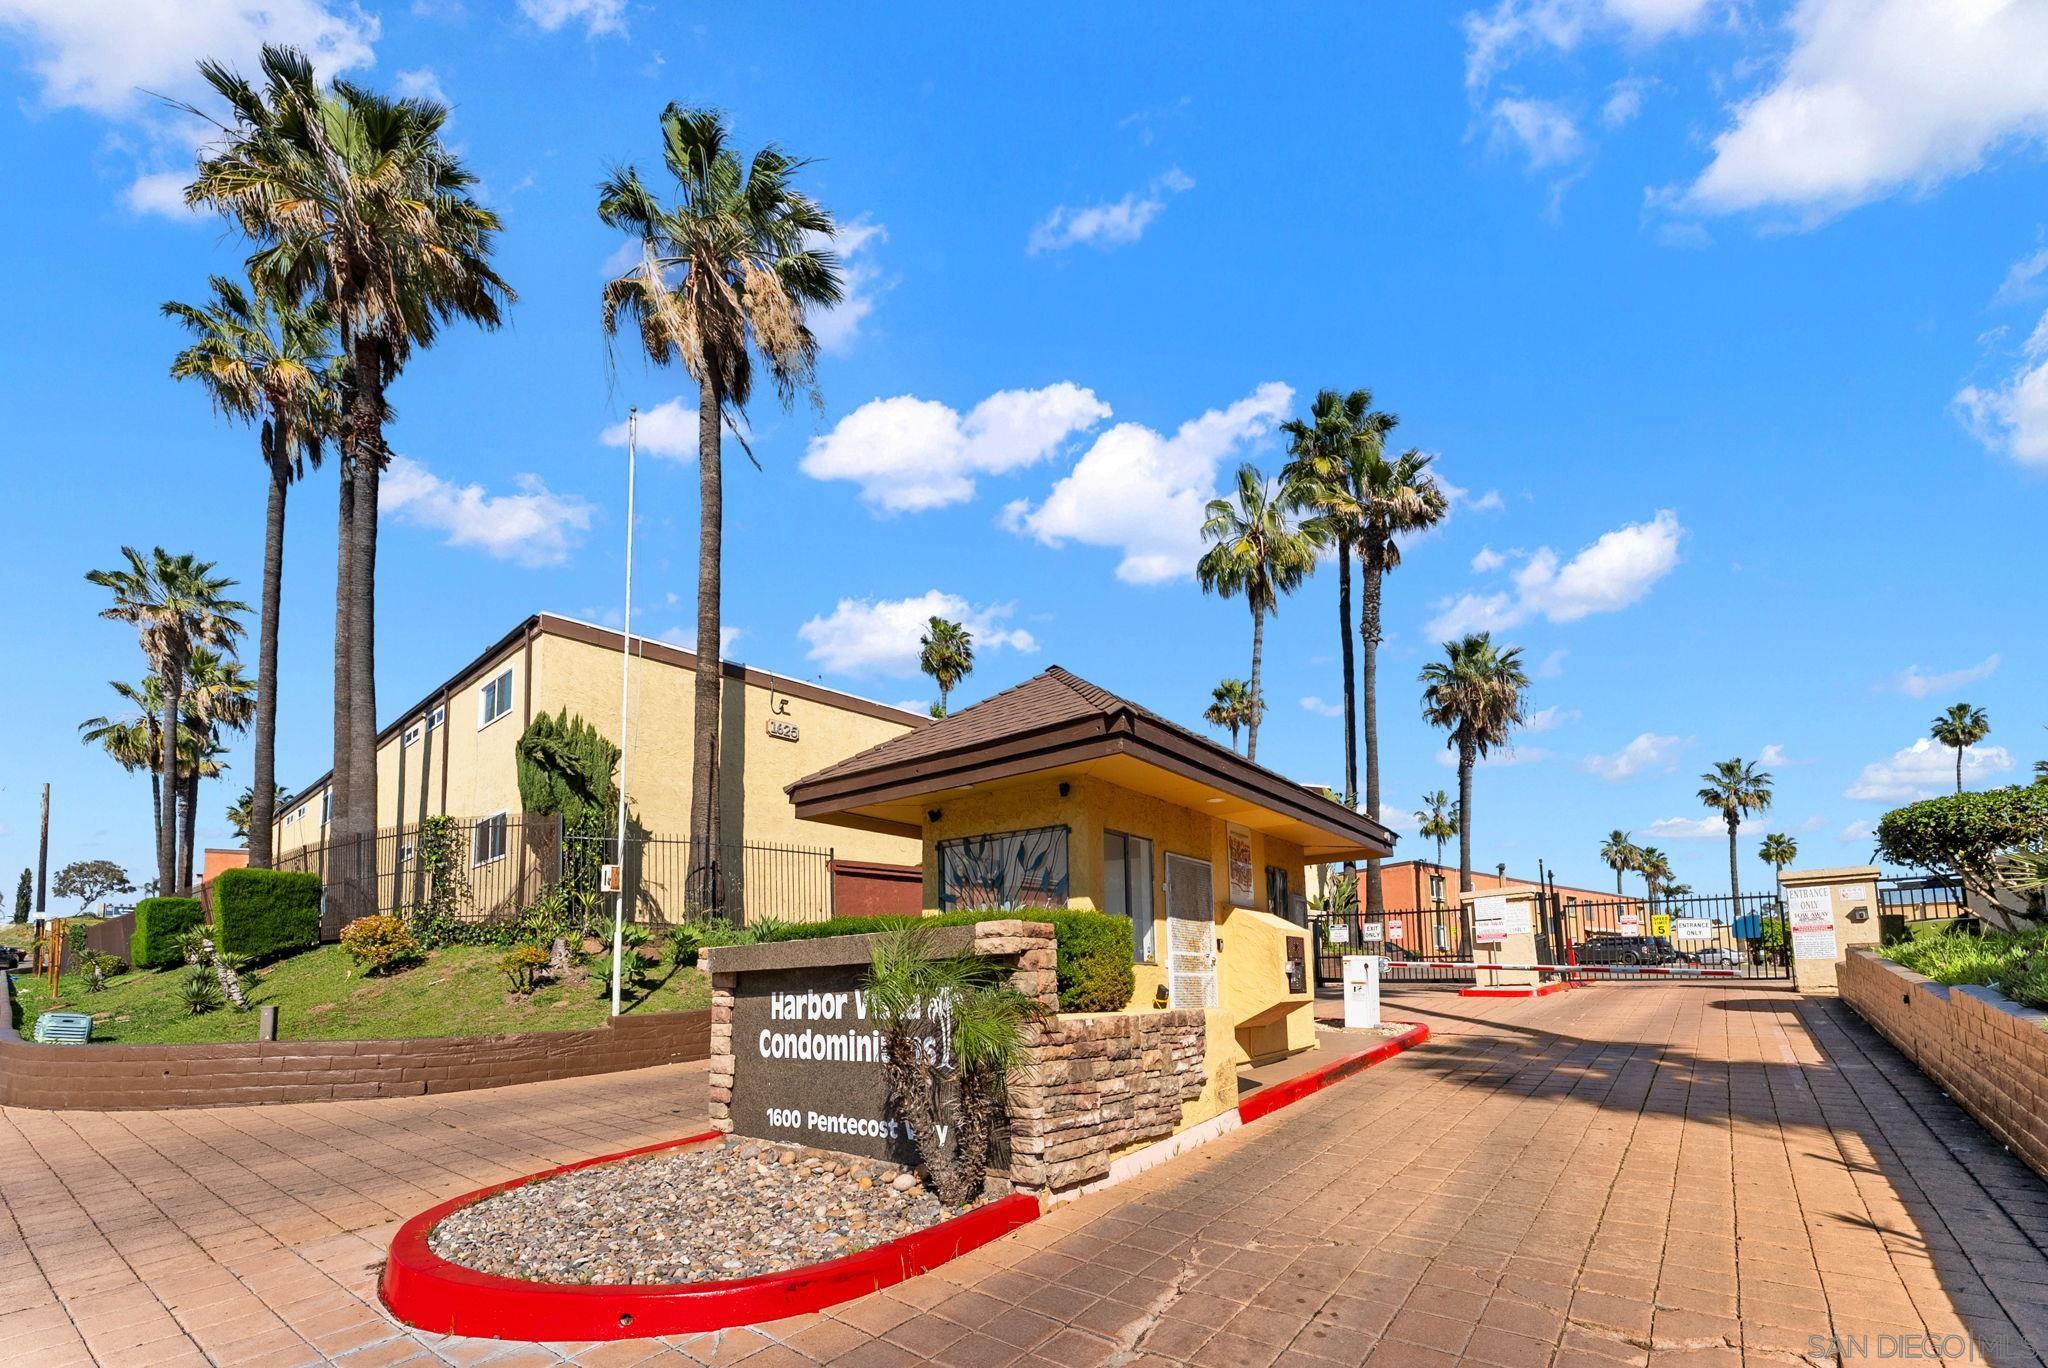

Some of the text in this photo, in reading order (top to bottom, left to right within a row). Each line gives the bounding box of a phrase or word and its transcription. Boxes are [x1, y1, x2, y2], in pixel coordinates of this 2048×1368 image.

[1789, 887, 1829, 900] ENTRANCE
[1800, 900, 1819, 910] ONLY
[1658, 926, 1665, 935] 5
[1678, 921, 1709, 929] ENTRANCE
[771, 989, 848, 1021] Harbor
[766, 1107, 802, 1129] 1600
[807, 1111, 898, 1139] Pentecost
